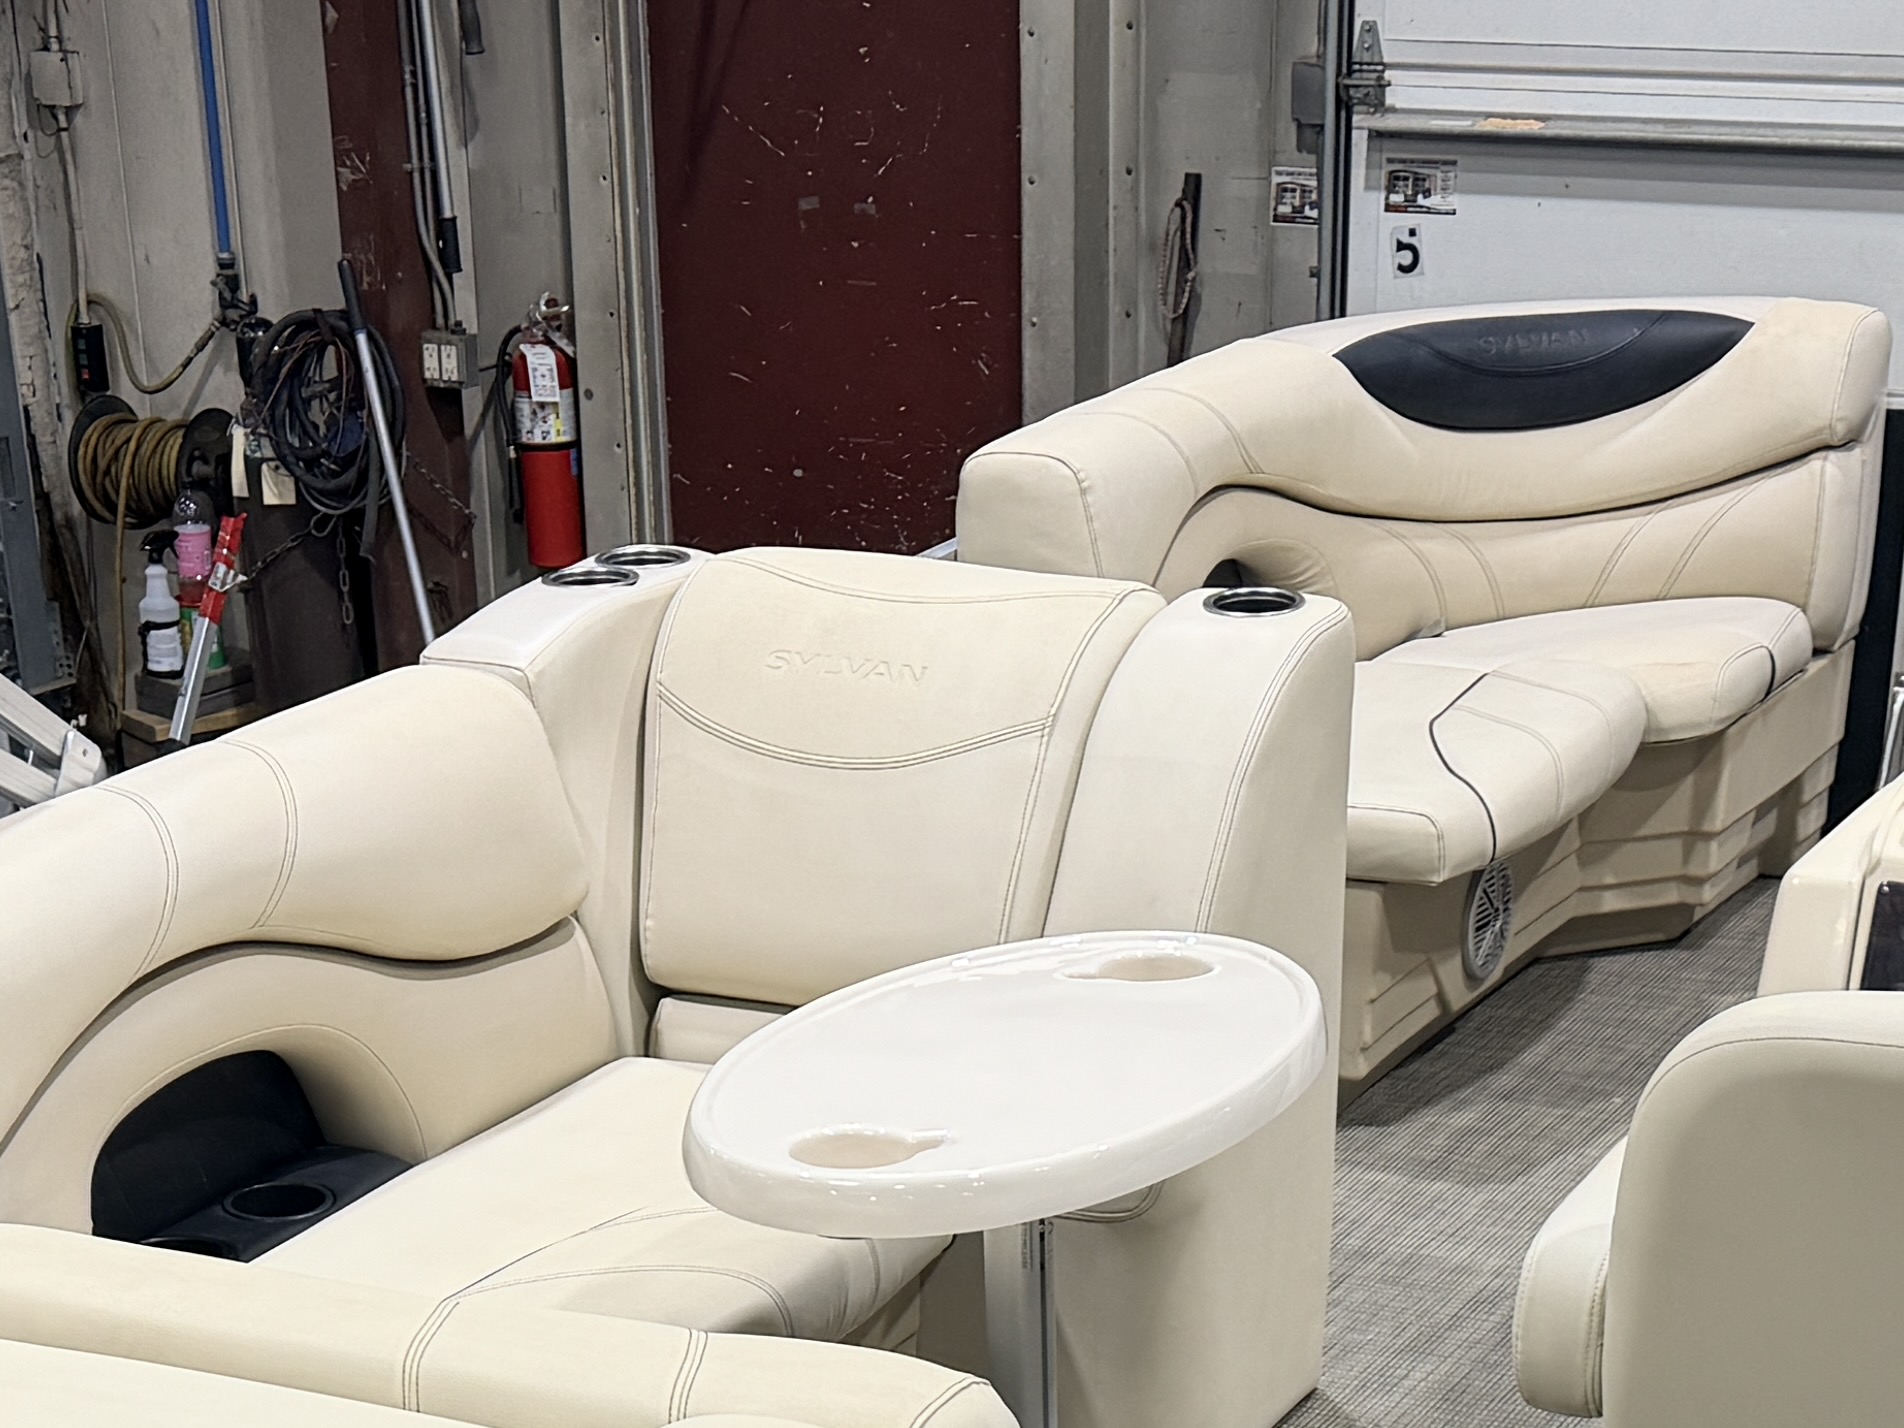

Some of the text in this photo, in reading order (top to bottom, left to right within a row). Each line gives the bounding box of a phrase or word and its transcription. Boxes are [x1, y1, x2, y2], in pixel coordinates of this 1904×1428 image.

[1396, 227, 1420, 274] 5
[1477, 327, 1589, 355] SYLVAN
[764, 649, 928, 685] SYLVAN
